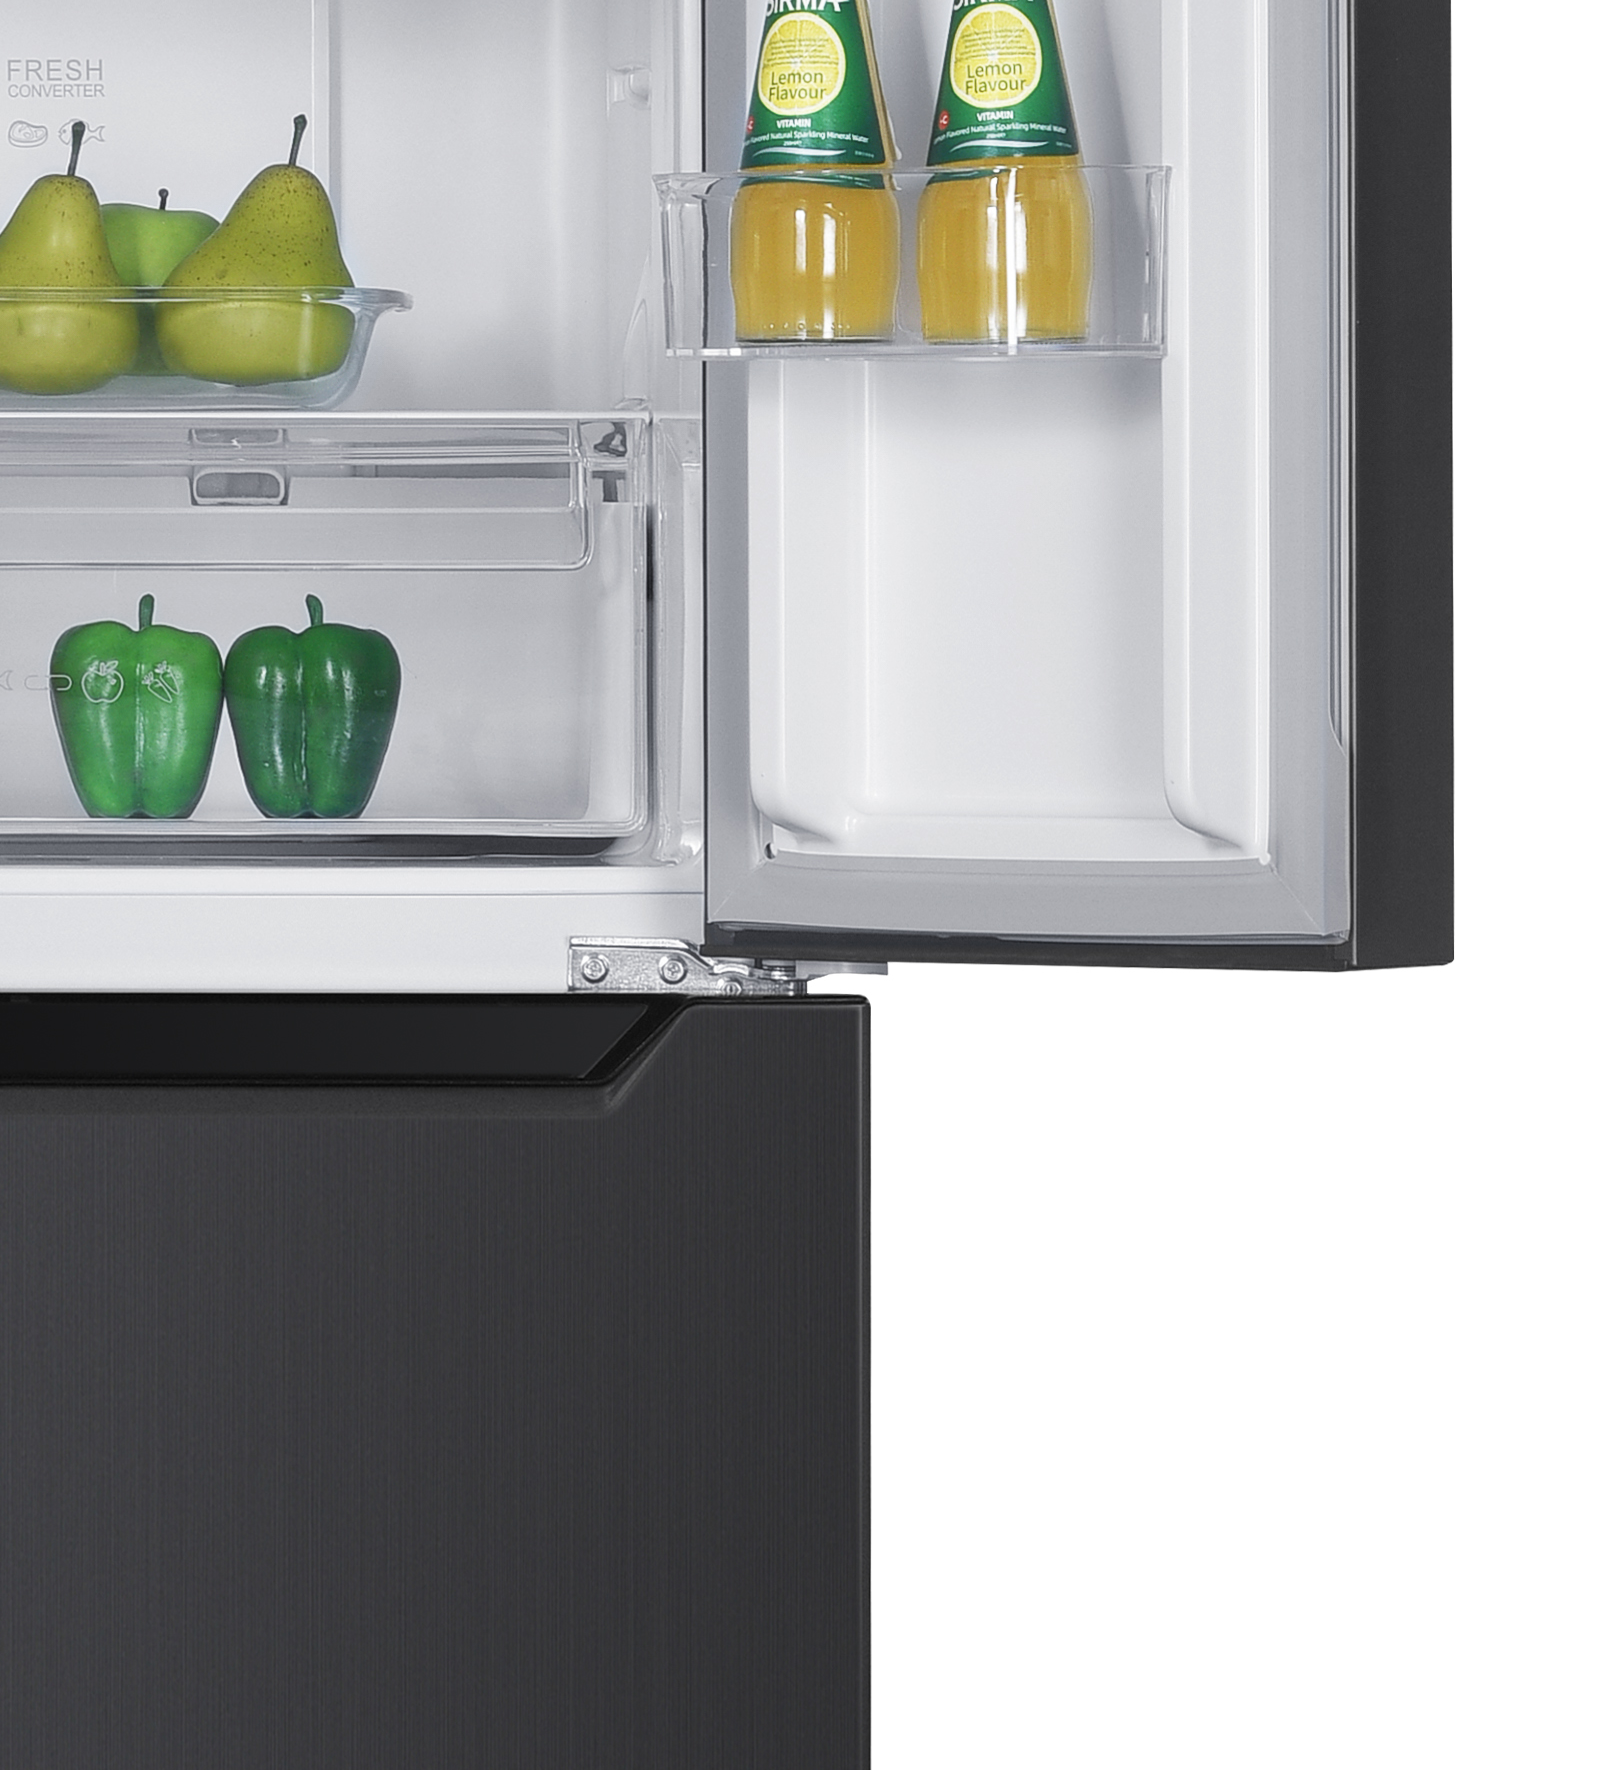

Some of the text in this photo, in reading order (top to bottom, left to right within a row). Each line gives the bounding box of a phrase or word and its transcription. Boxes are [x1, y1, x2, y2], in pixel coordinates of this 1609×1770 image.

[7, 59, 103, 81] FRESH
[967, 62, 1023, 79] Lemon
[771, 72, 823, 86] Lemon
[8, 84, 105, 97] CONVERTER
[965, 78, 1027, 95] Flavour
[768, 86, 827, 102] Flavour
[976, 110, 1014, 121] VITAMIN
[776, 118, 812, 129] VITAMIN
[996, 122, 1029, 132] Sparkling
[793, 129, 825, 140] Sparkling
[827, 131, 851, 141] Mineral
